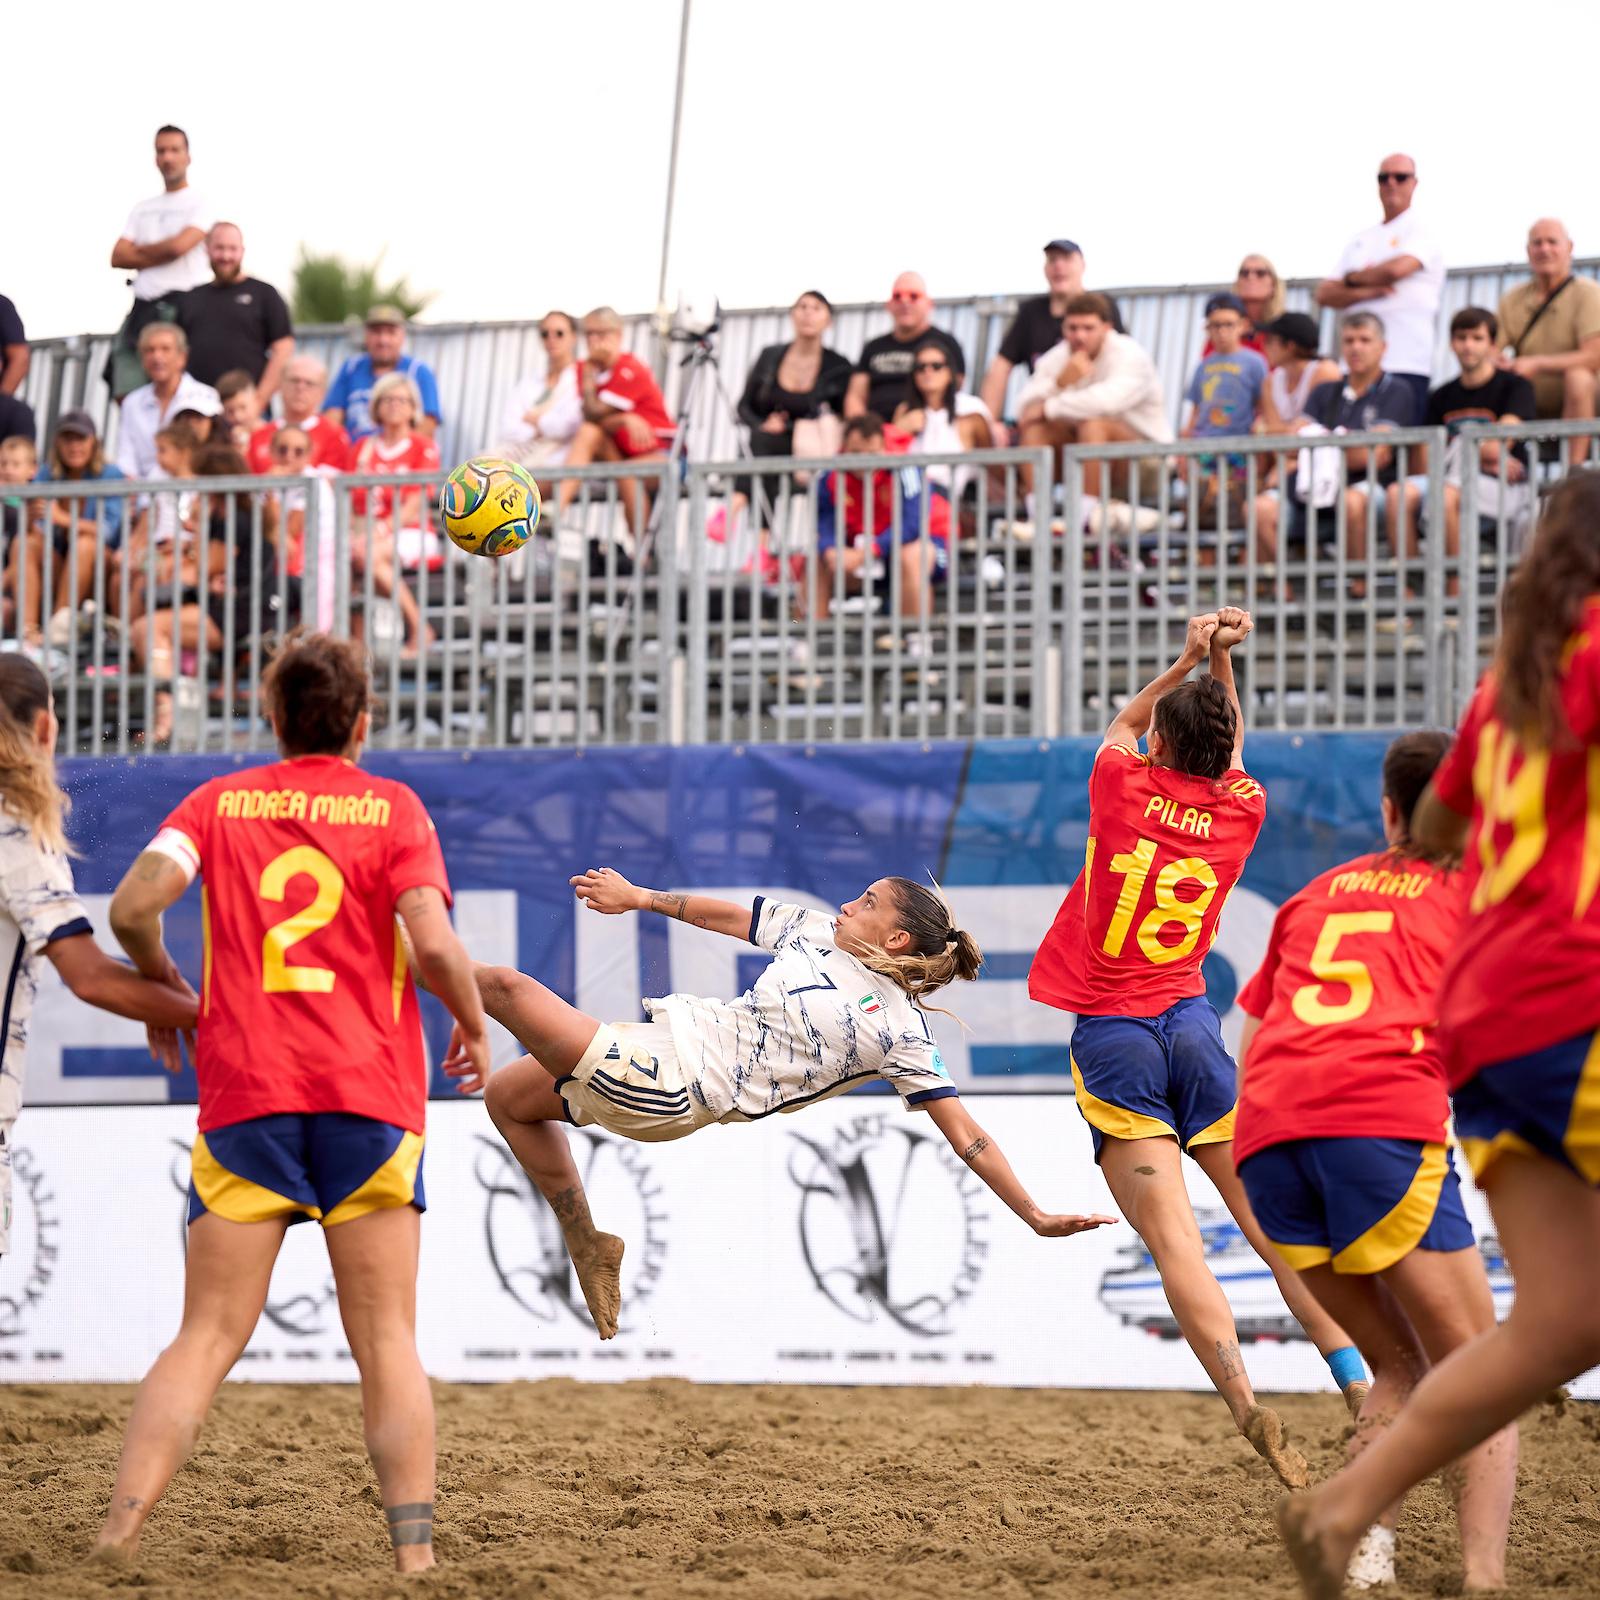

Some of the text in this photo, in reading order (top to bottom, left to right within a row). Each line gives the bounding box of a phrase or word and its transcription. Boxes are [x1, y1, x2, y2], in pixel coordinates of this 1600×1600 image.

[217, 789, 391, 827] ANDREA MIRÓN
[1144, 795, 1213, 839] PILAR
[1103, 837, 1219, 964] 18
[1327, 869, 1433, 900] MANAU
[259, 844, 345, 993] 2
[787, 972, 838, 996] 7
[1291, 910, 1395, 1026] 5
